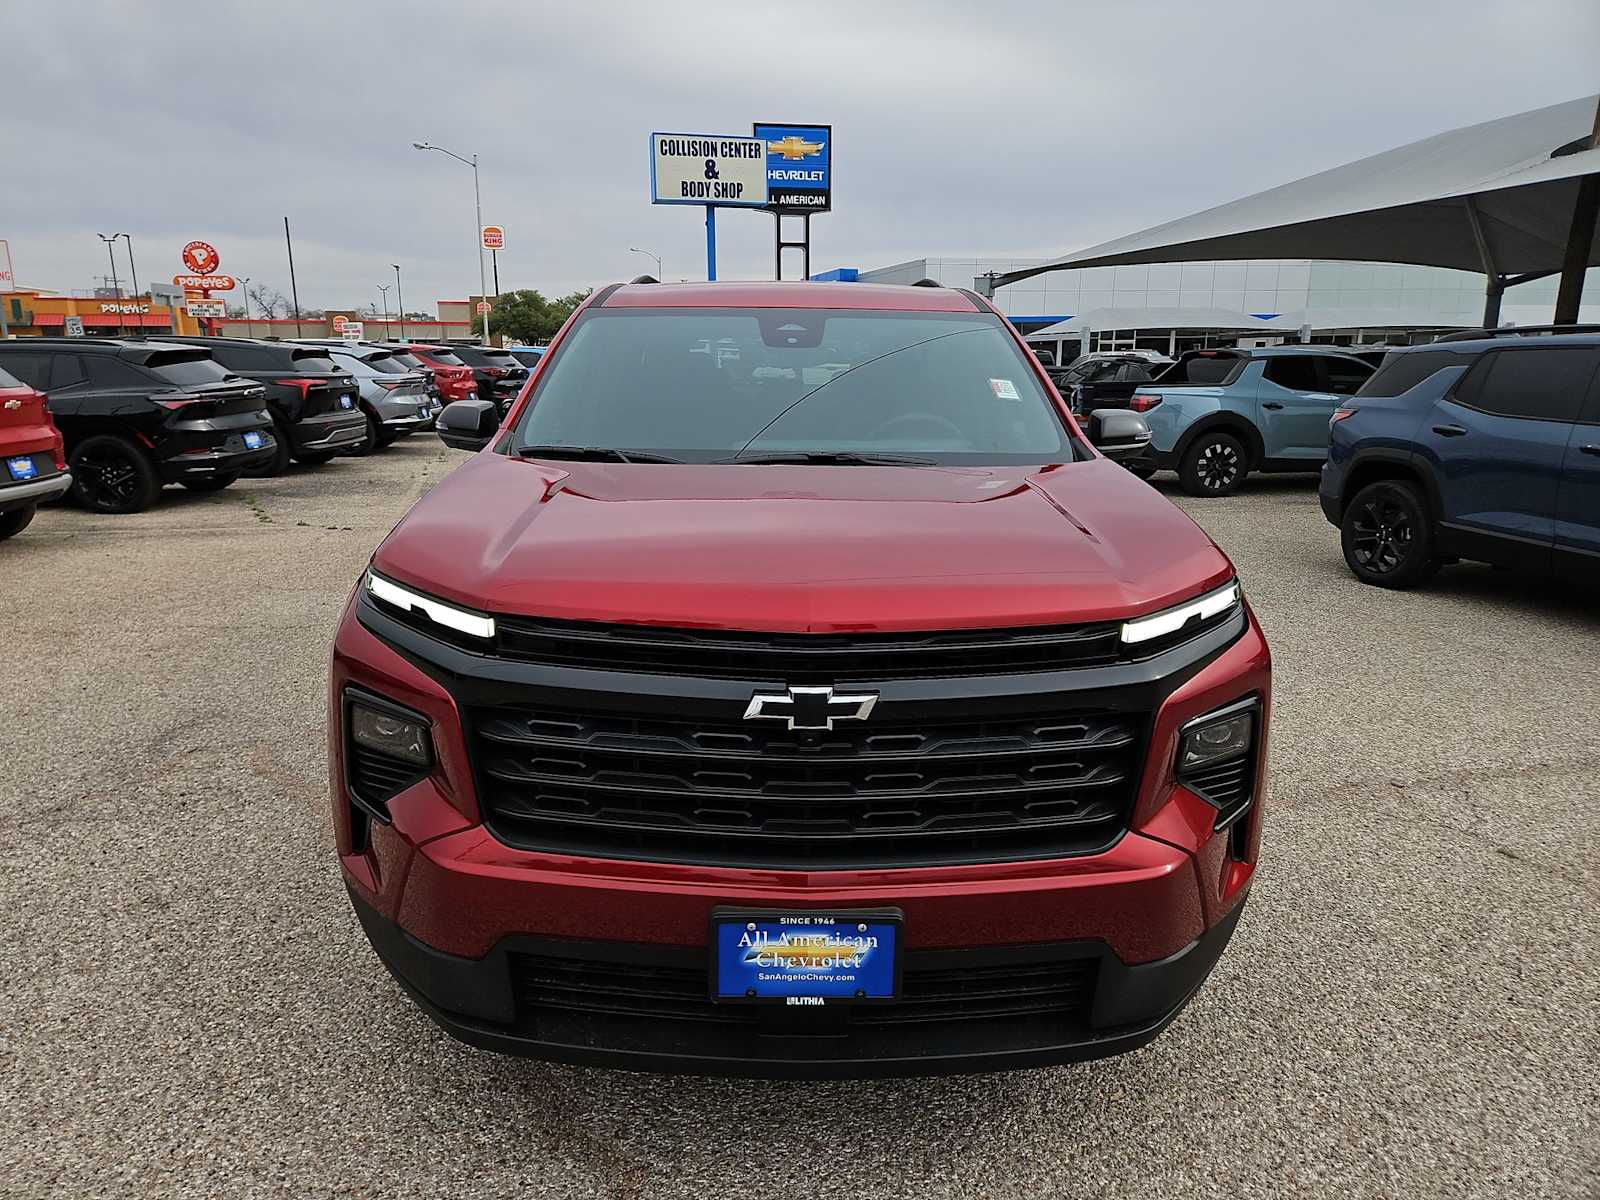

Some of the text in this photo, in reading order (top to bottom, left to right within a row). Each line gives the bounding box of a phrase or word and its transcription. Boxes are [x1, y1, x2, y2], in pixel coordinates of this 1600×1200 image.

[660, 139, 761, 159] COLLISION CENTER
[704, 159, 720, 180] &
[768, 170, 824, 181] HEVROLET
[681, 181, 743, 199] BODY SHOP
[779, 195, 826, 205] AMERICAN
[69, 326, 82, 335] 35
[780, 917, 835, 925] SINCE 1946
[737, 930, 878, 948] All American
[756, 951, 864, 968] Chevrolet
[758, 972, 855, 982] SanAngeloChevy.com
